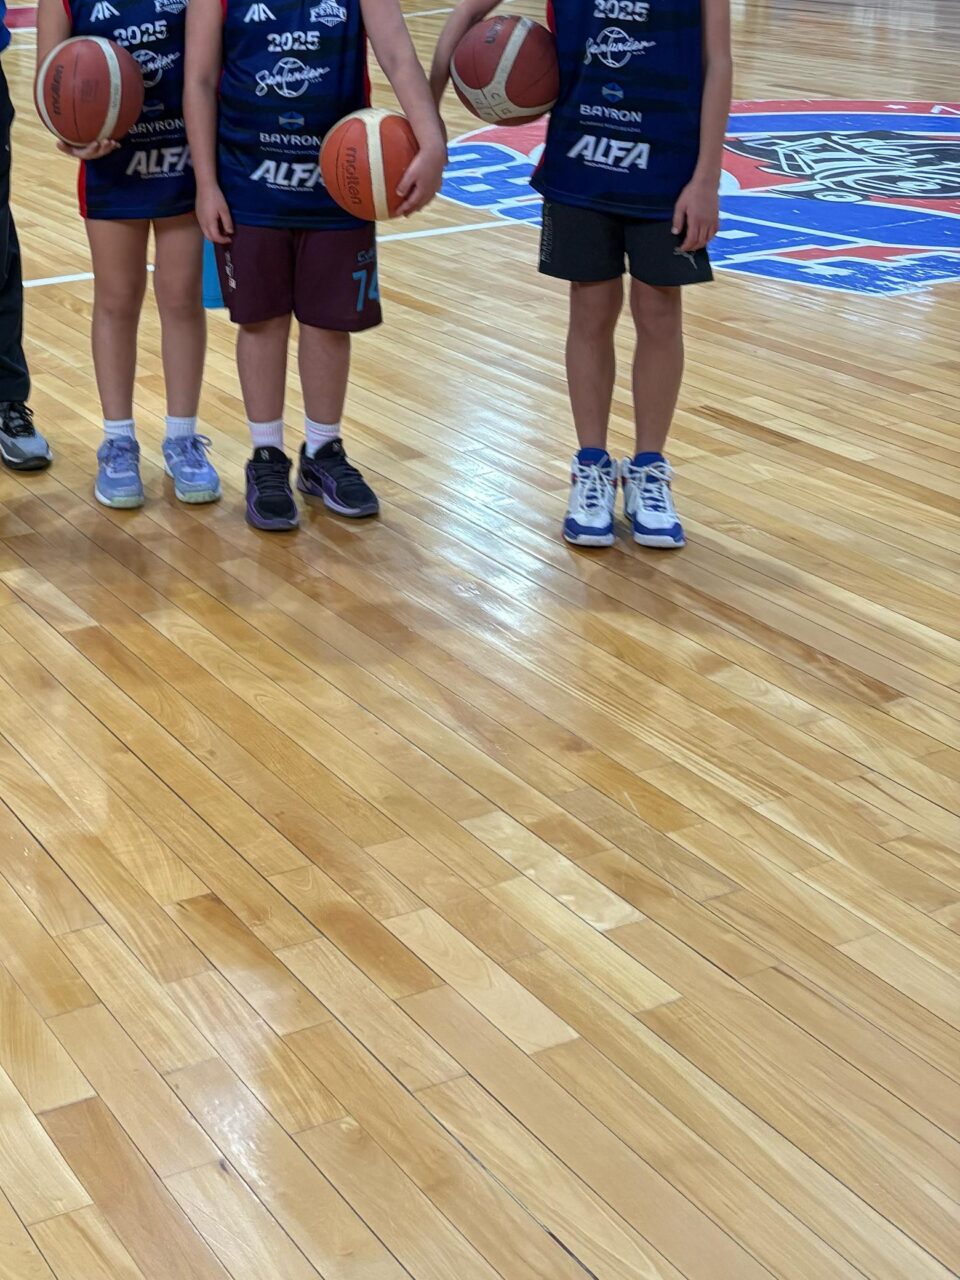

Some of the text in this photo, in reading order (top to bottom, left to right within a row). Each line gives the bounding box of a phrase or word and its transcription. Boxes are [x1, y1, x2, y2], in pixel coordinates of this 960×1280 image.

[113, 20, 168, 47] 2025
[266, 30, 320, 52] 2025
[580, 104, 643, 122] BAYRON
[259, 132, 321, 146] BAYRON
[566, 134, 650, 170] ALFA
[345, 147, 362, 204] molten
[352, 269, 380, 311] 74
